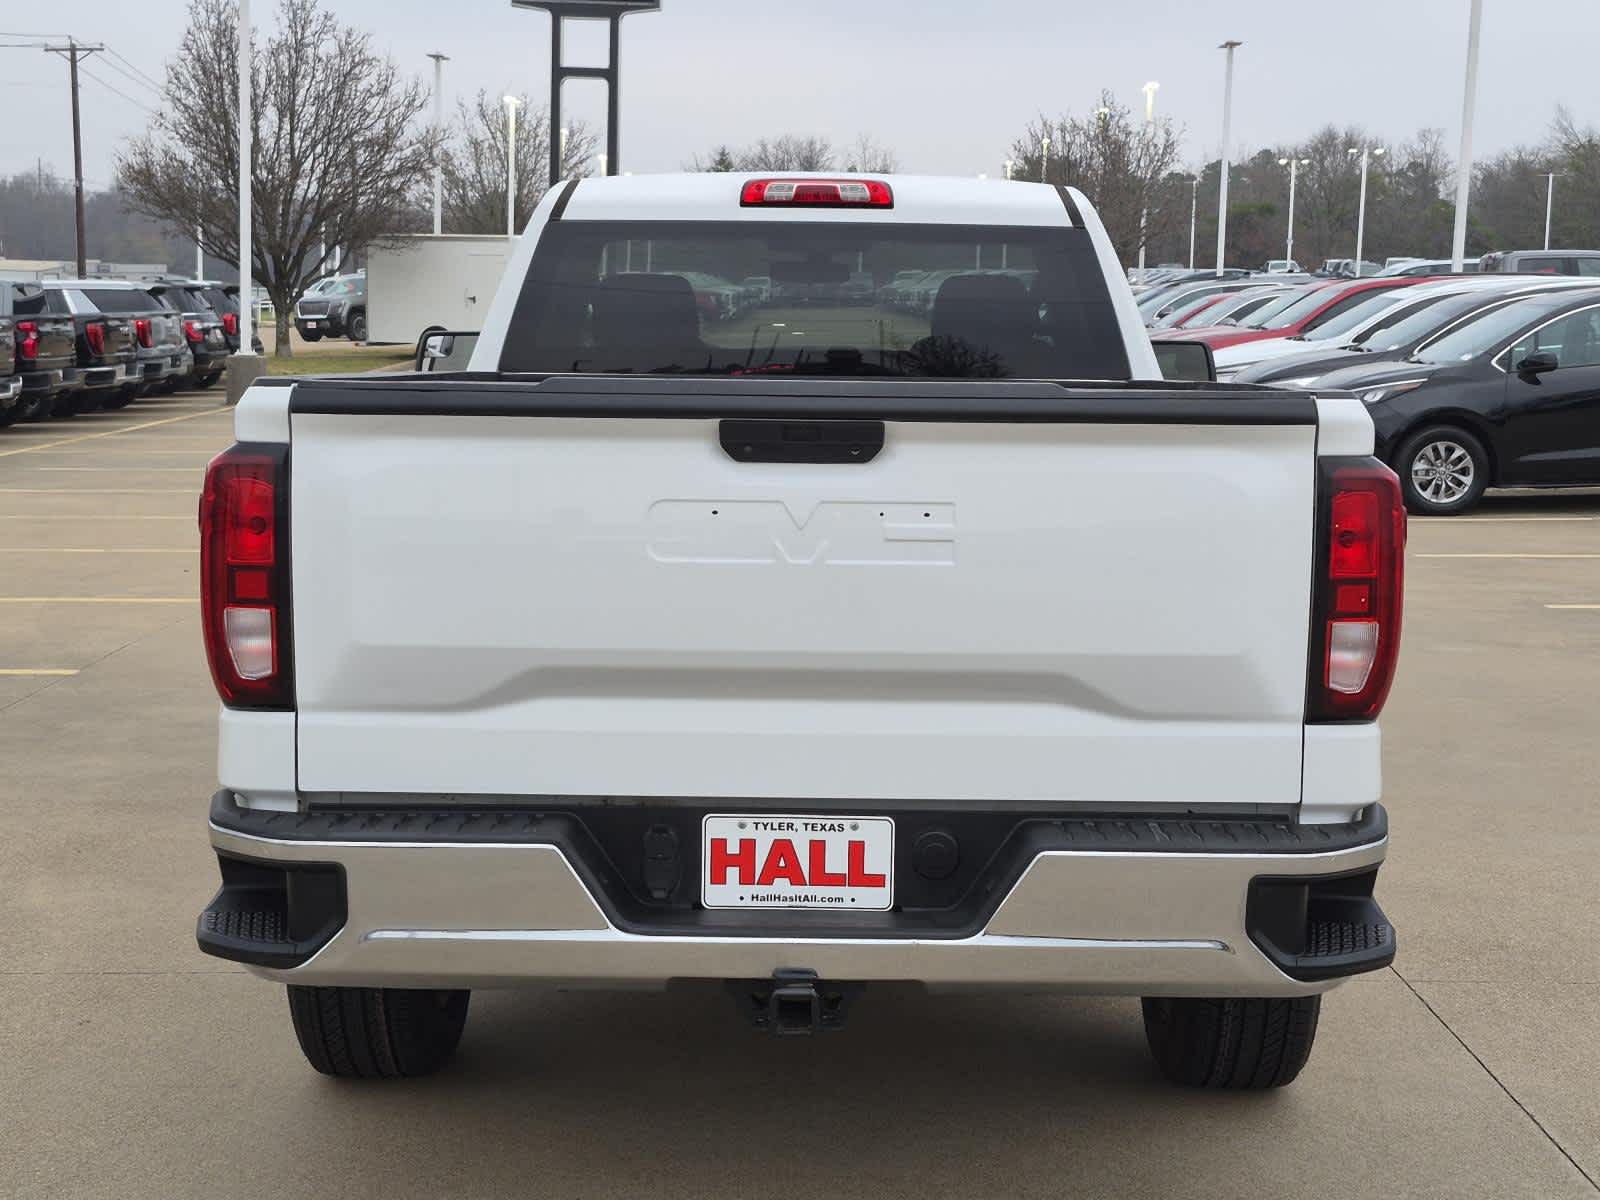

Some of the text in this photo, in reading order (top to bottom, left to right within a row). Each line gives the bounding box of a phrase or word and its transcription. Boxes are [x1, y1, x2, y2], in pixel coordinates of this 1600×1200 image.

[752, 821, 845, 832] TYLER, TEXAS
[710, 838, 886, 888] HALL
[751, 893, 844, 903] HallHasItAll.com
